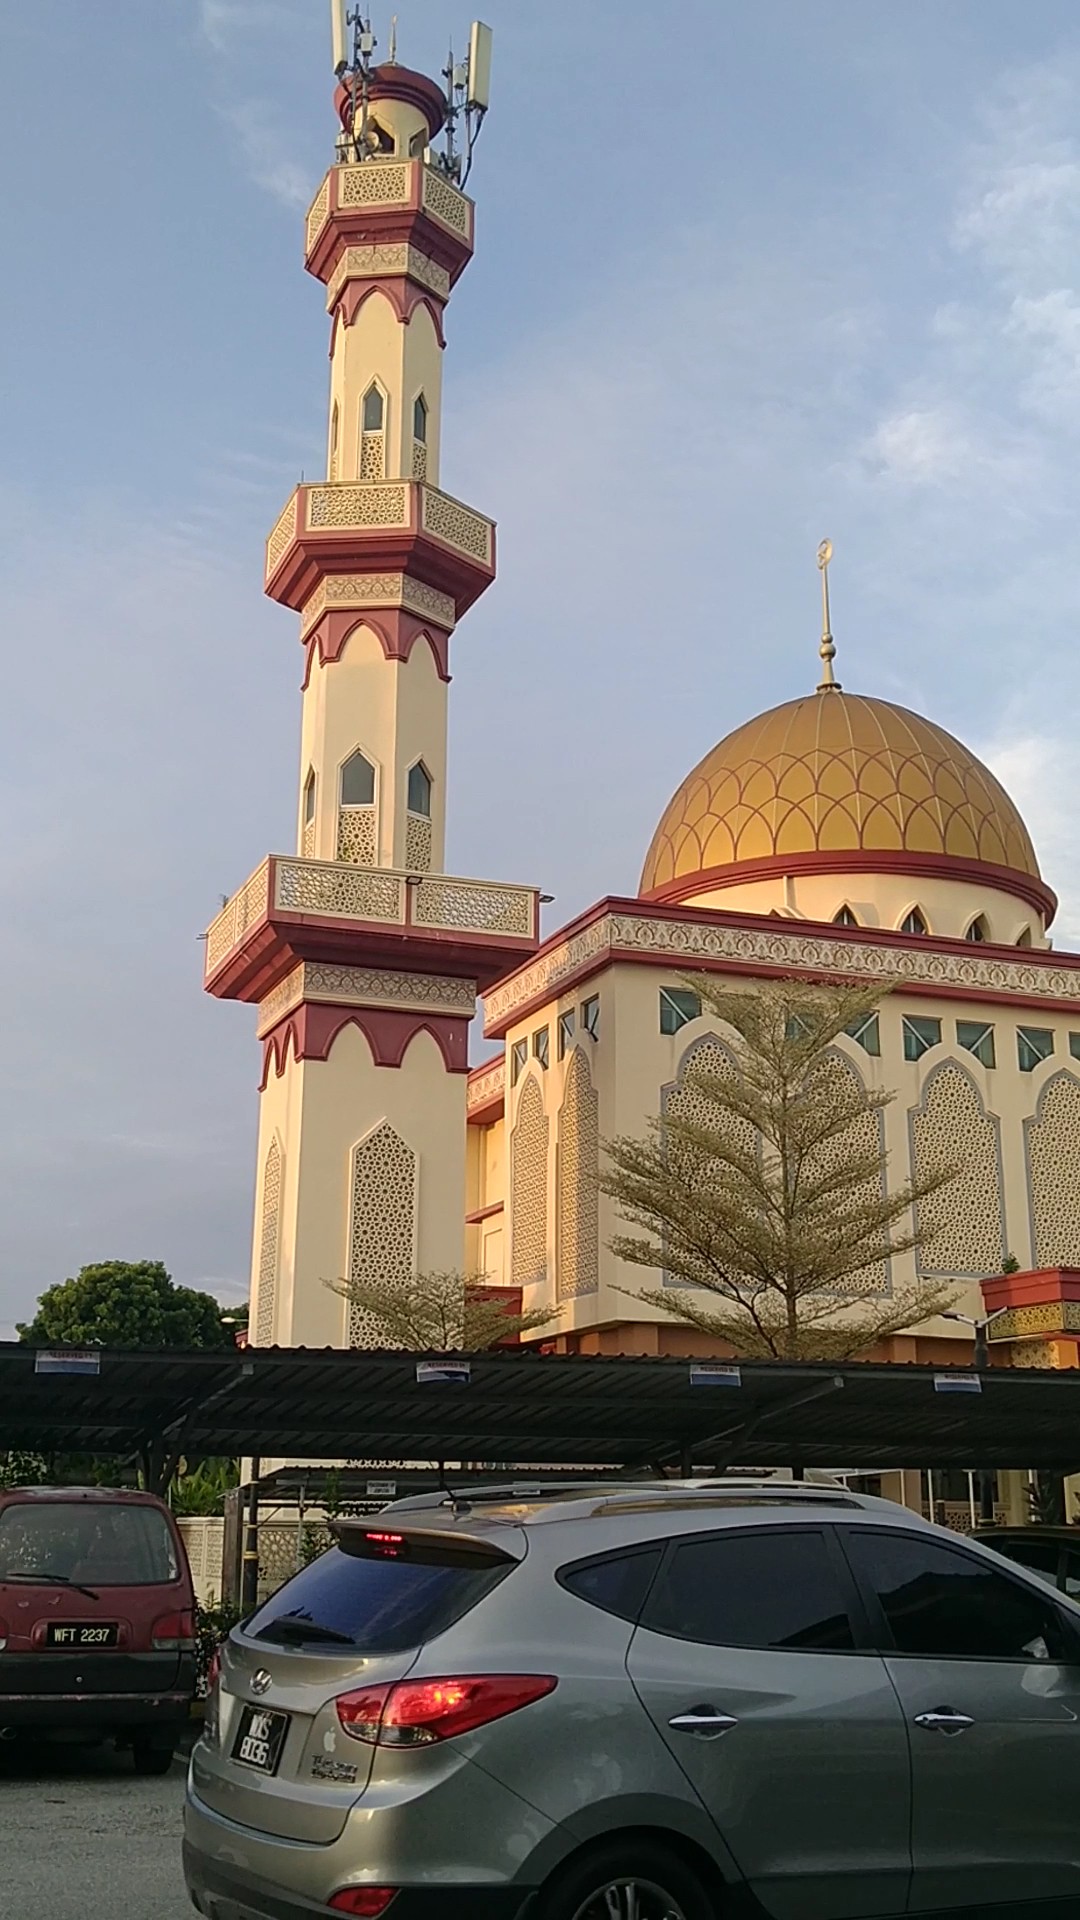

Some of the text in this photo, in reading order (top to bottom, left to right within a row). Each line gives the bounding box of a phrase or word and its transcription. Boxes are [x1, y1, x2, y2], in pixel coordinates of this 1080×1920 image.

[54, 1628, 110, 1642] WFT 2237
[239, 1735, 270, 1765] 8036
